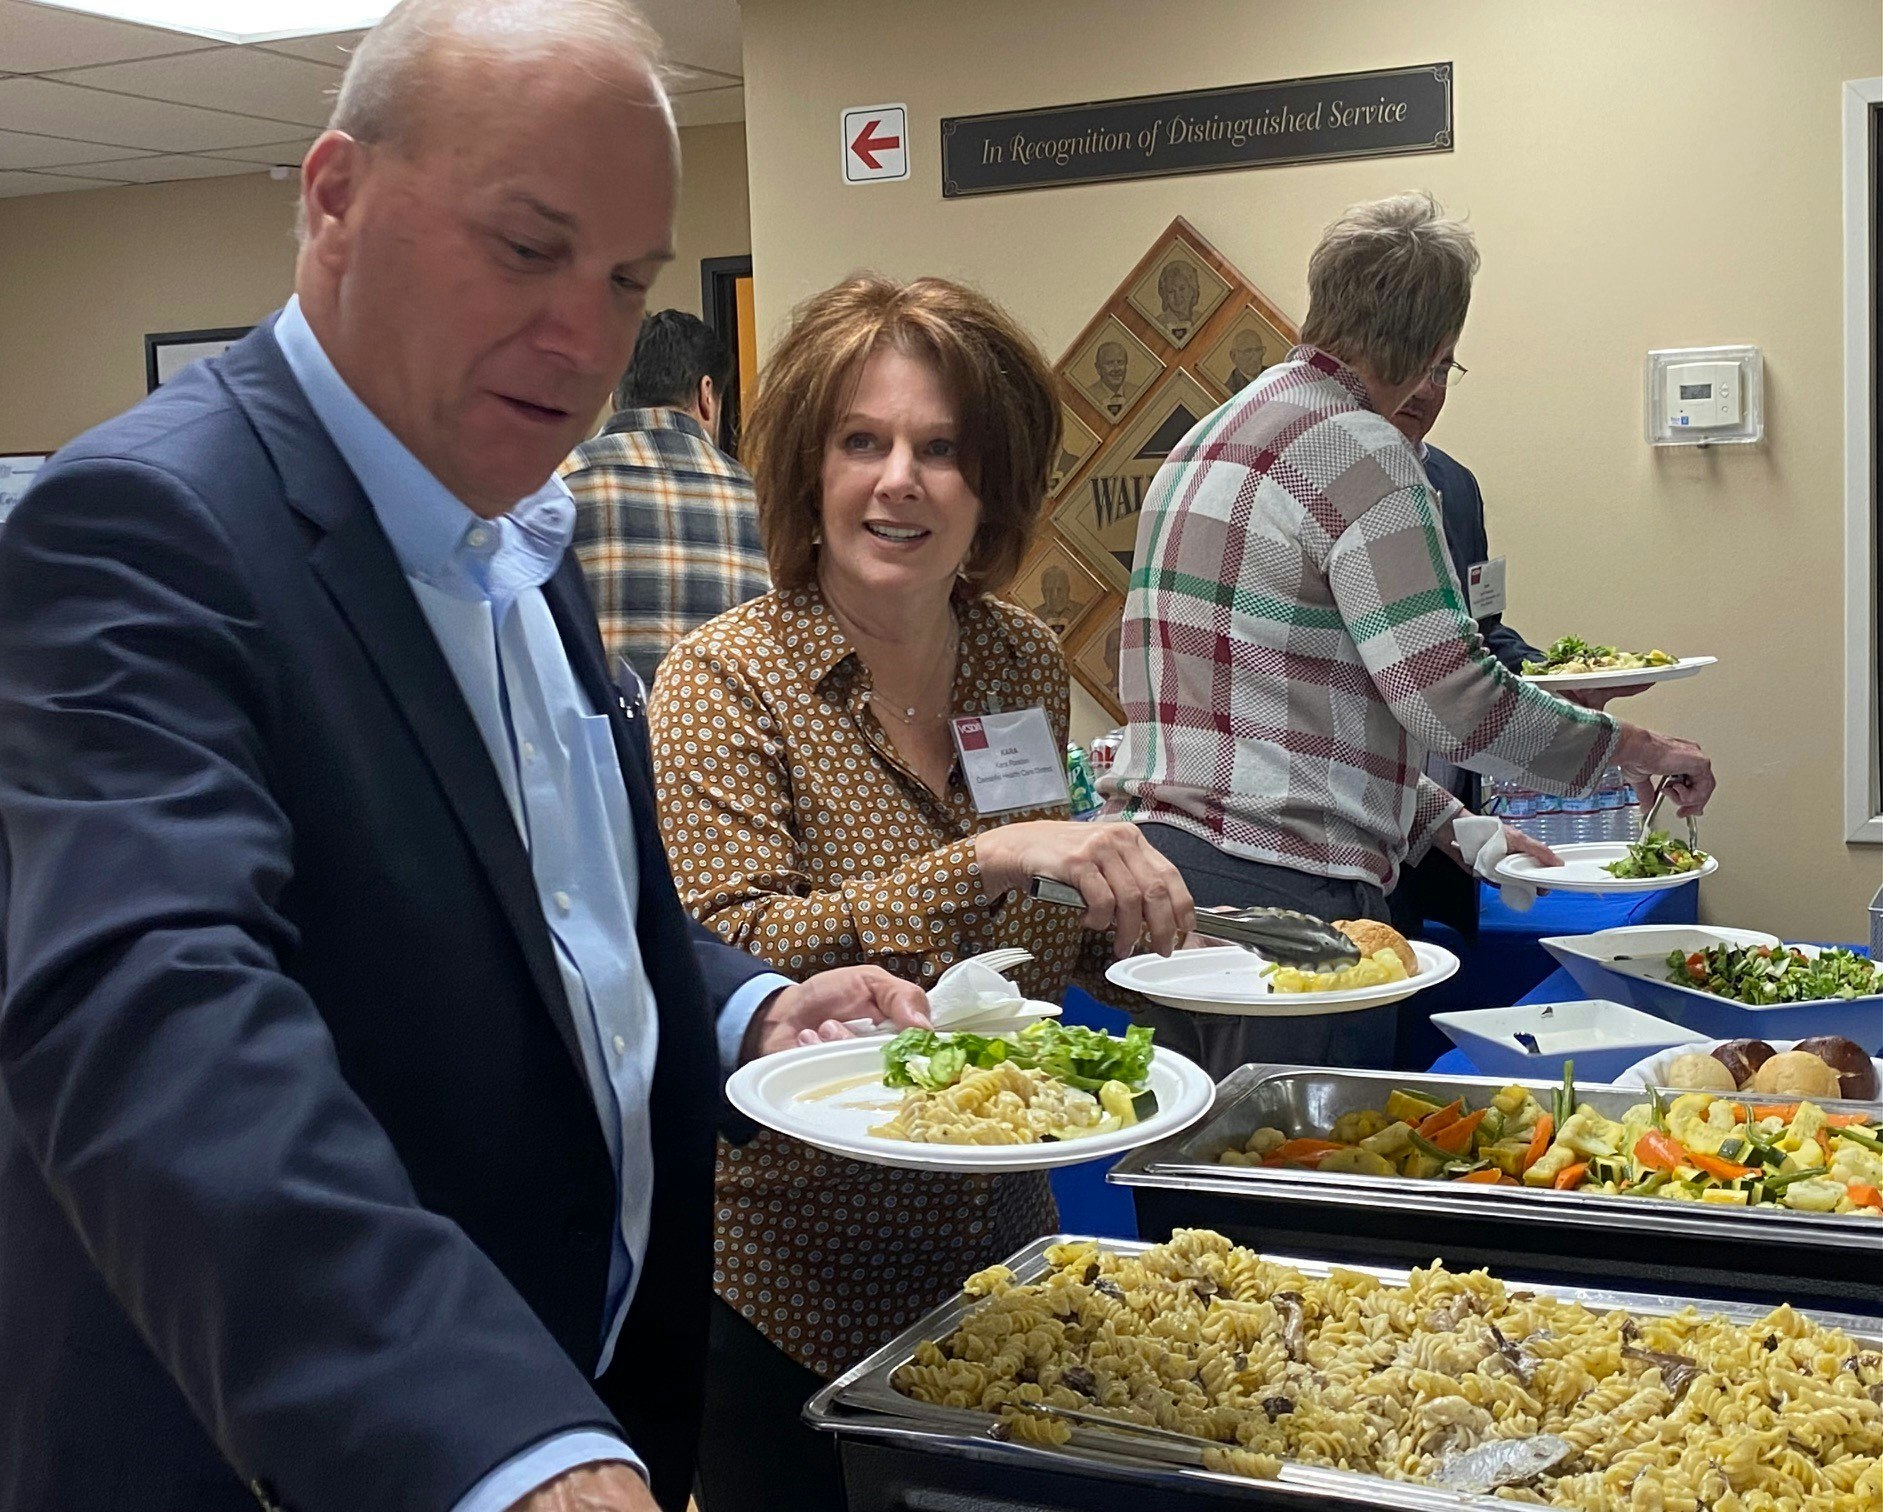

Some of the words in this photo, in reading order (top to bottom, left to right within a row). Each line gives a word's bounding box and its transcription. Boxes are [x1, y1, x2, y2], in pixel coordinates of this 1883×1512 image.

[982, 138, 1003, 165] In
[1010, 127, 1131, 166] Recognition
[1137, 119, 1162, 157] of
[1166, 102, 1323, 148] Distinguished
[1328, 96, 1408, 129] Service
[1090, 476, 1154, 531] WAL
